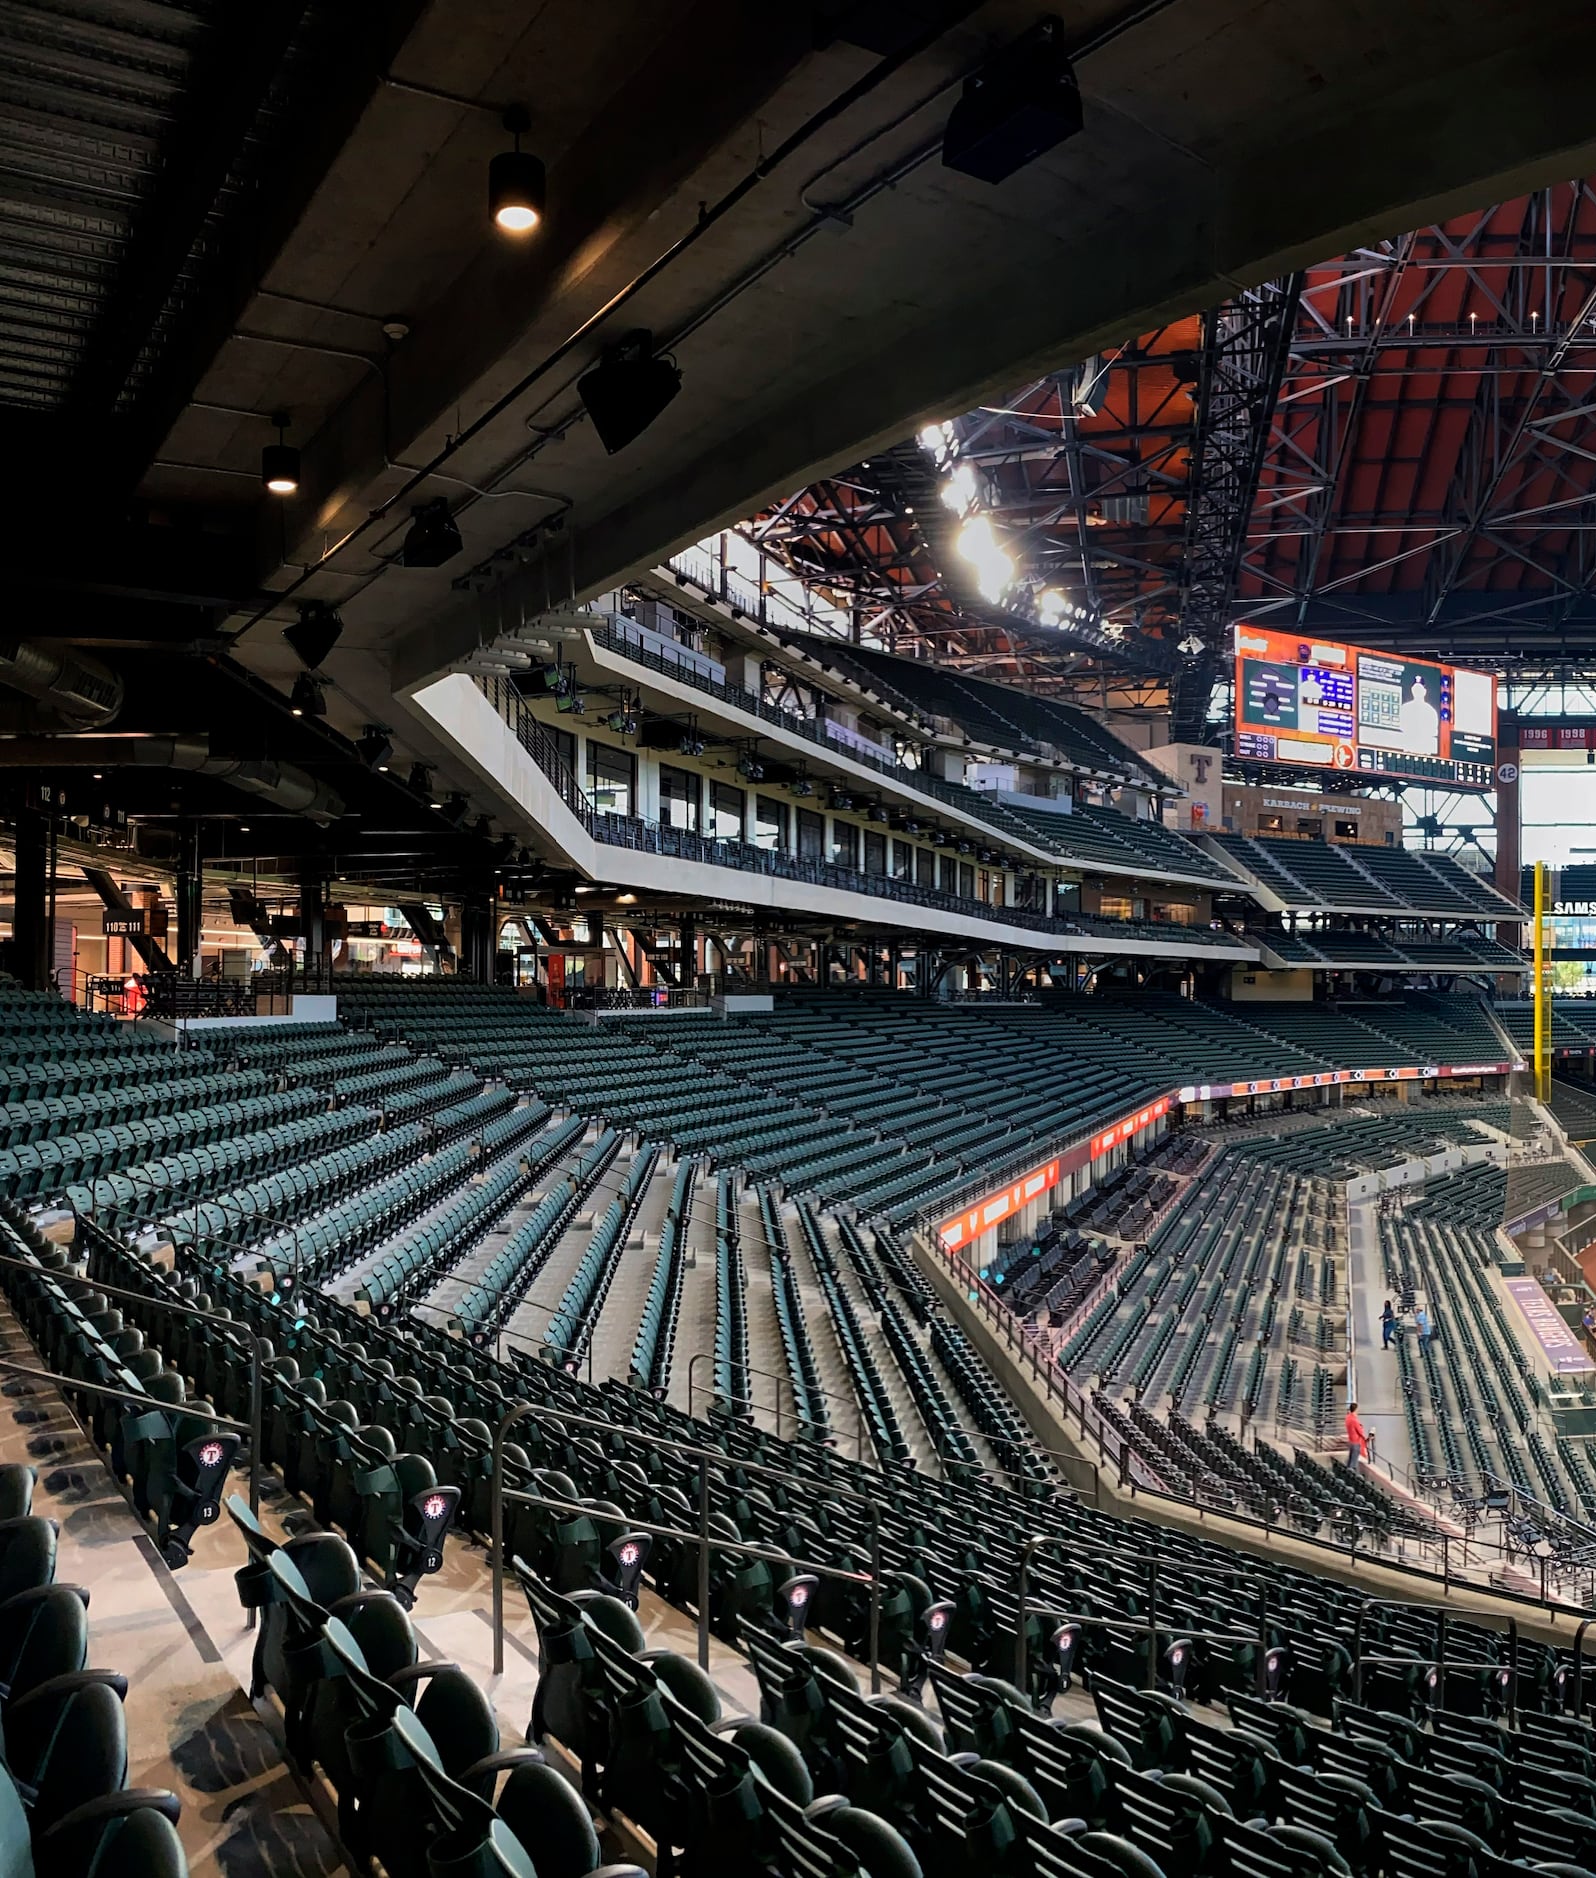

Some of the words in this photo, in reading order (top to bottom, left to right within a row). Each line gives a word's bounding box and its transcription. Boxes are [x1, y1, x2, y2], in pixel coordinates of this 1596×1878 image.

[1523, 729, 1548, 739] 1996
[1560, 728, 1586, 739] 1998
[1500, 768, 1515, 779] 42
[1263, 799, 1310, 811] KARBACH
[1318, 804, 1362, 815] BREWING
[106, 922, 119, 933] 110
[129, 922, 140, 932] 111
[1520, 1298, 1554, 1321] TEXAS
[1534, 1318, 1574, 1349] RANGERS
[203, 1507, 213, 1518] 13
[427, 1557, 437, 1567] 12
